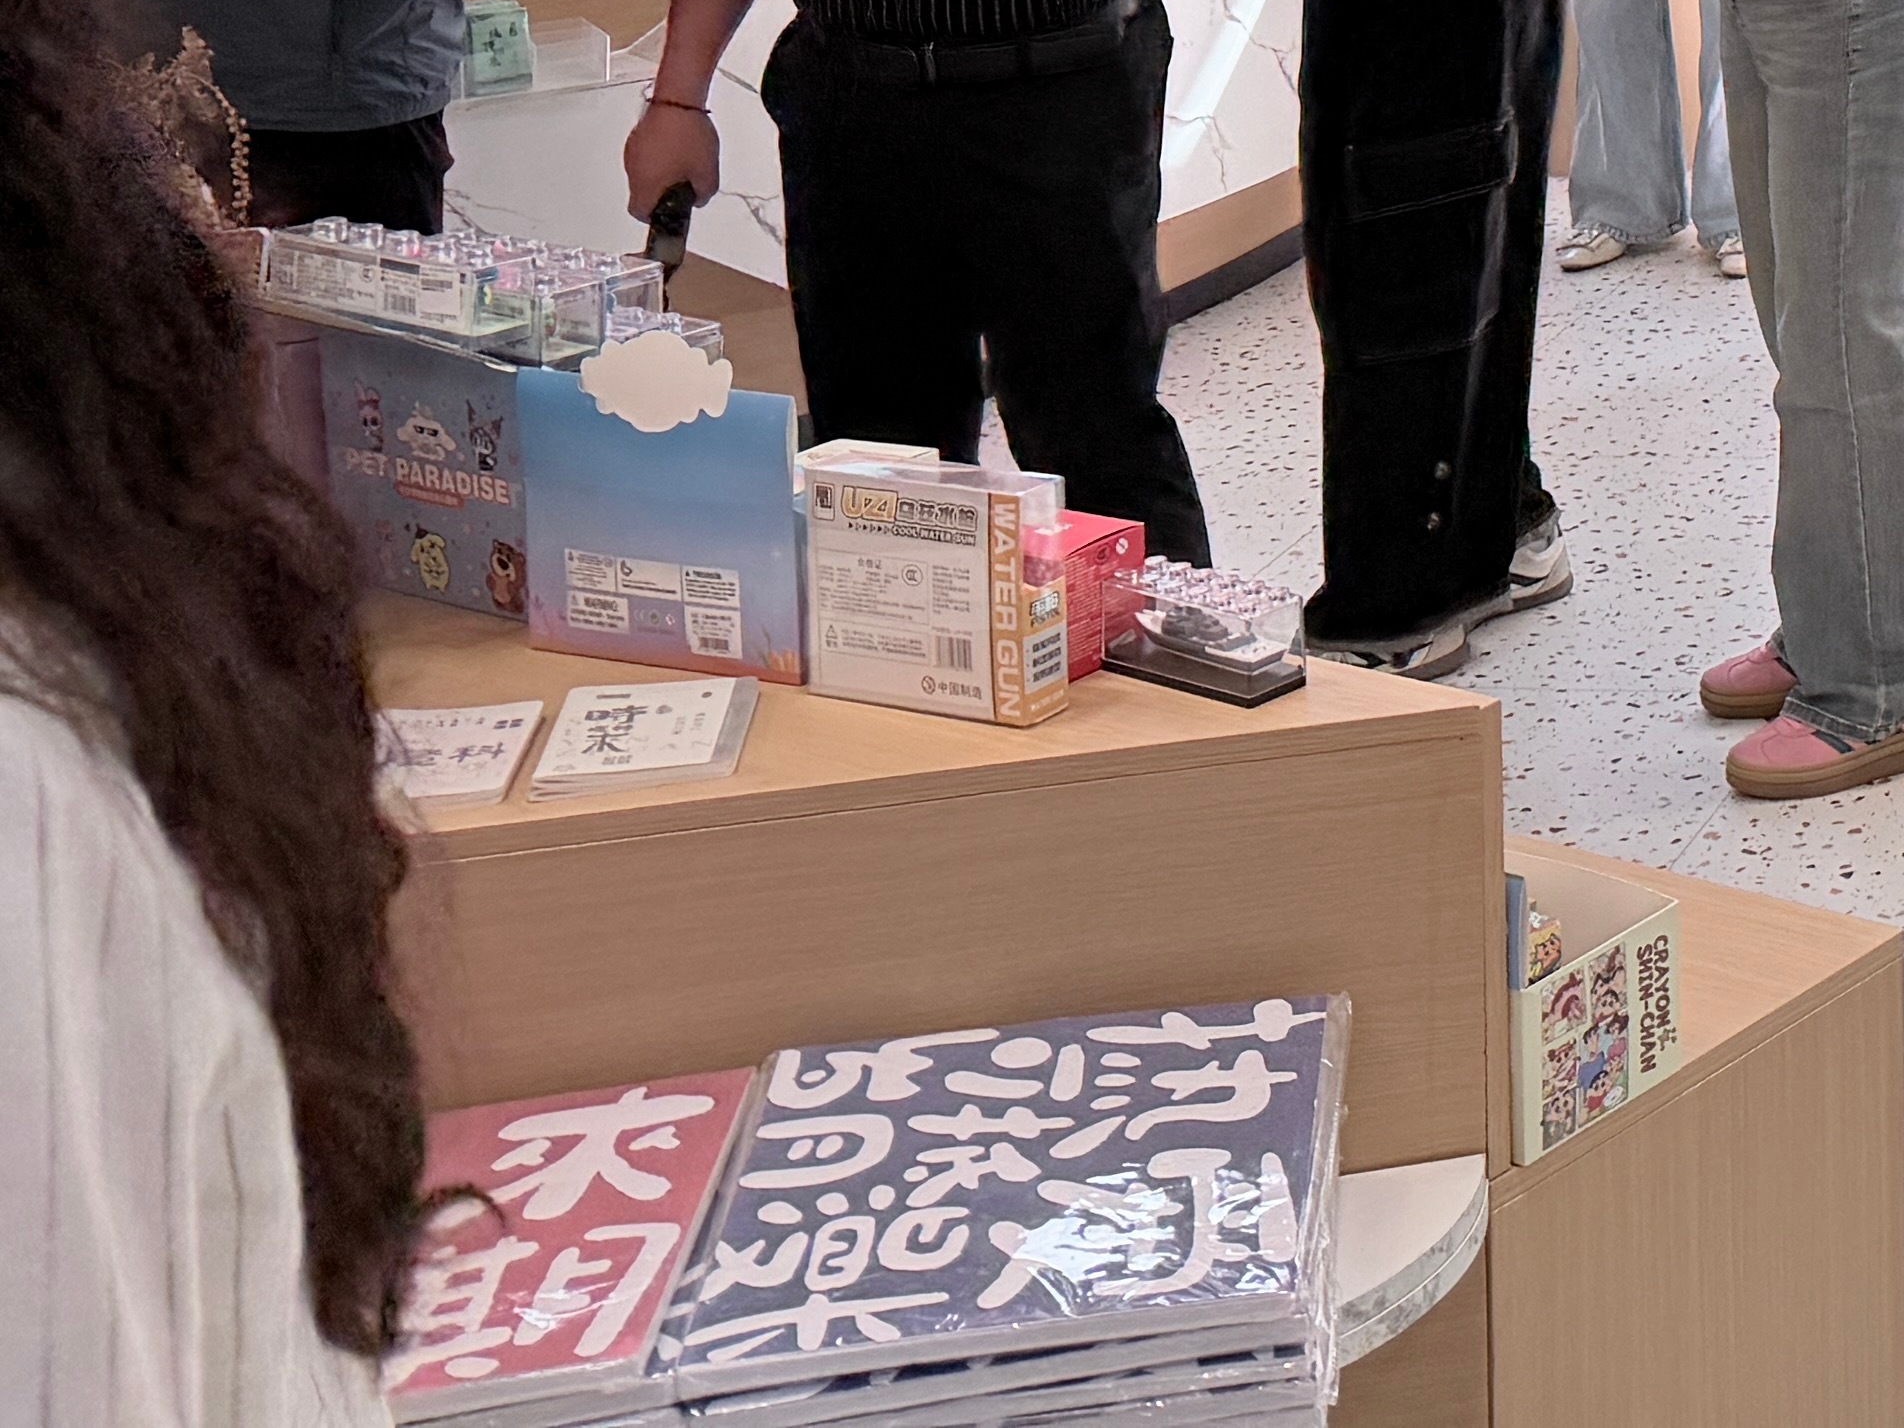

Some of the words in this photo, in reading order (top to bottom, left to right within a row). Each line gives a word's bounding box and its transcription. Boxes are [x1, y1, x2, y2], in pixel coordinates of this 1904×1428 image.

[345, 448, 388, 476] PET
[396, 458, 511, 505] PARADISE
[993, 503, 1017, 632] WATER
[937, 681, 983, 701] 中国制造
[997, 639, 1021, 718] GUN
[1636, 943, 1657, 1074] SHIN-CHAN
[1653, 934, 1671, 1029] CRAYON
